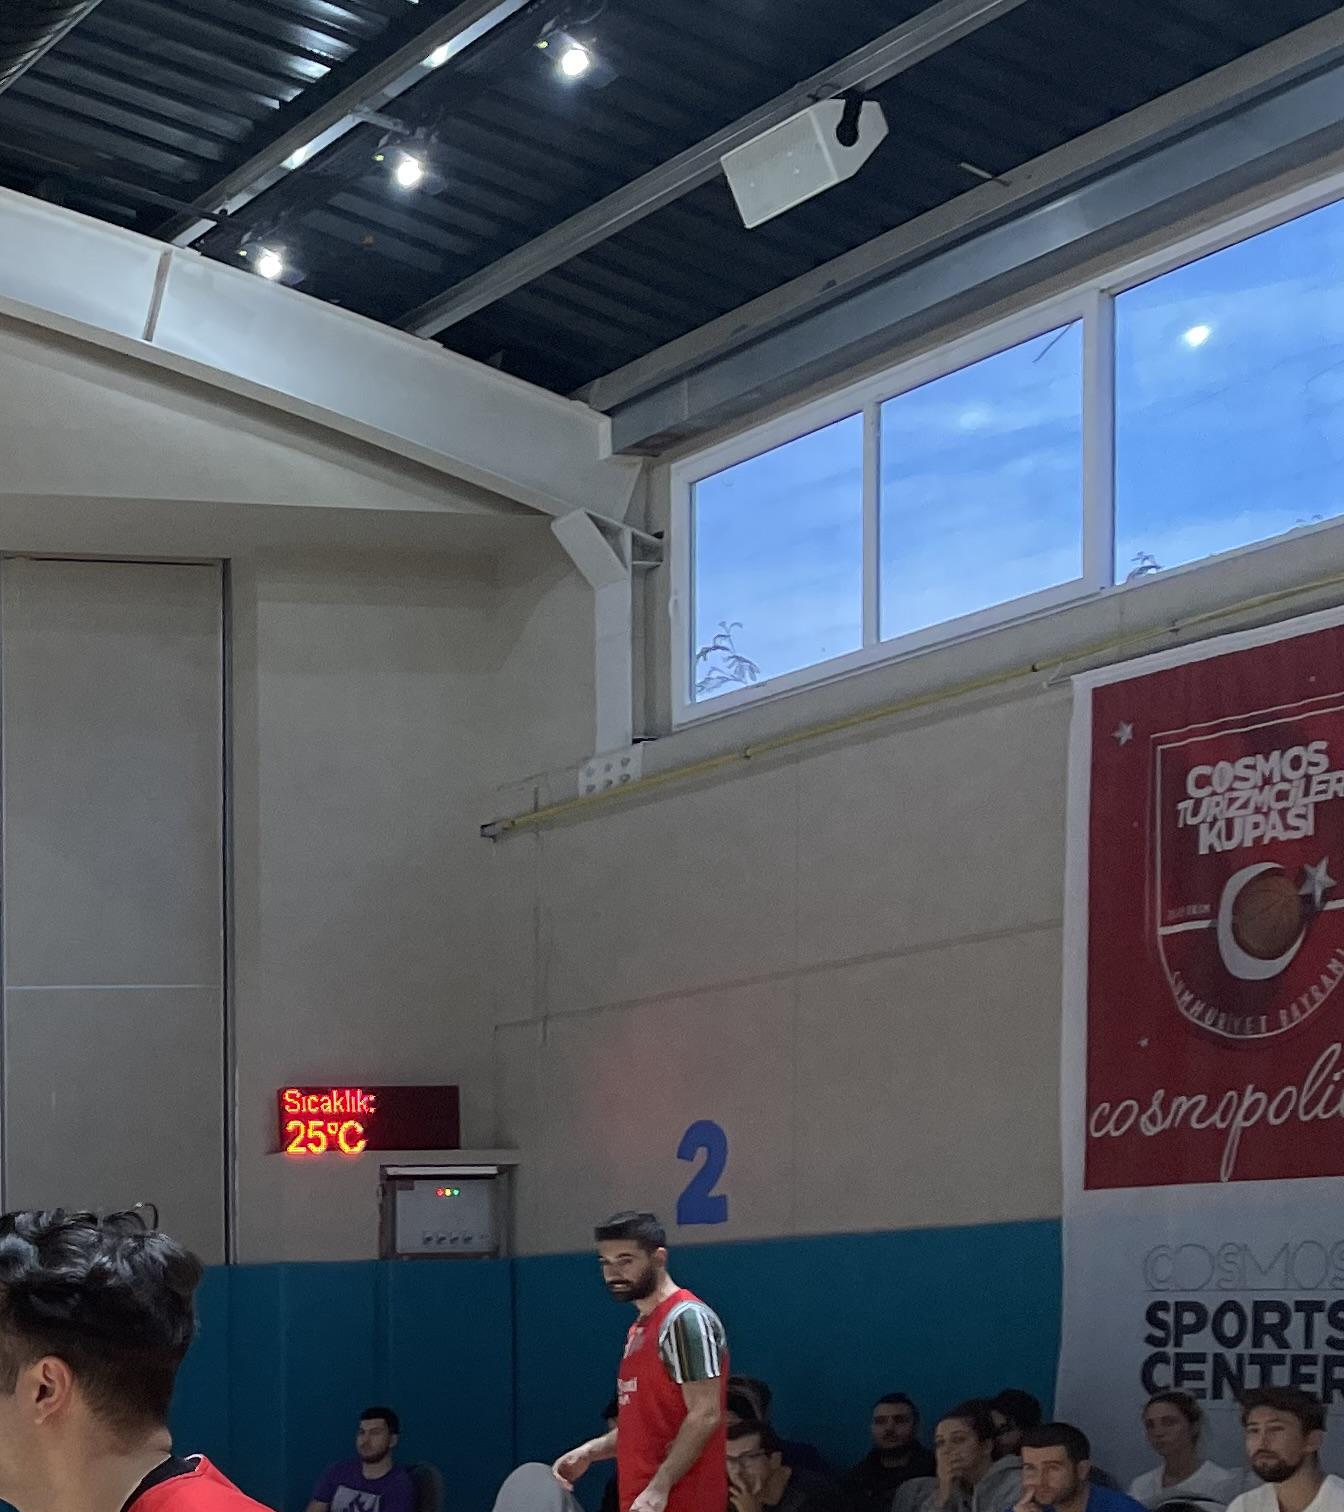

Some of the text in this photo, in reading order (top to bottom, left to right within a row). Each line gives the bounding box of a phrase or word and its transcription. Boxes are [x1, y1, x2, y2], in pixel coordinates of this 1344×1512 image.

[1186, 740, 1330, 798] COSMOS
[1198, 803, 1314, 855] KUPASI
[676, 1120, 728, 1225] 2
[1143, 1241, 1344, 1291] COSMOS
[1144, 1299, 1344, 1350] SPORTS
